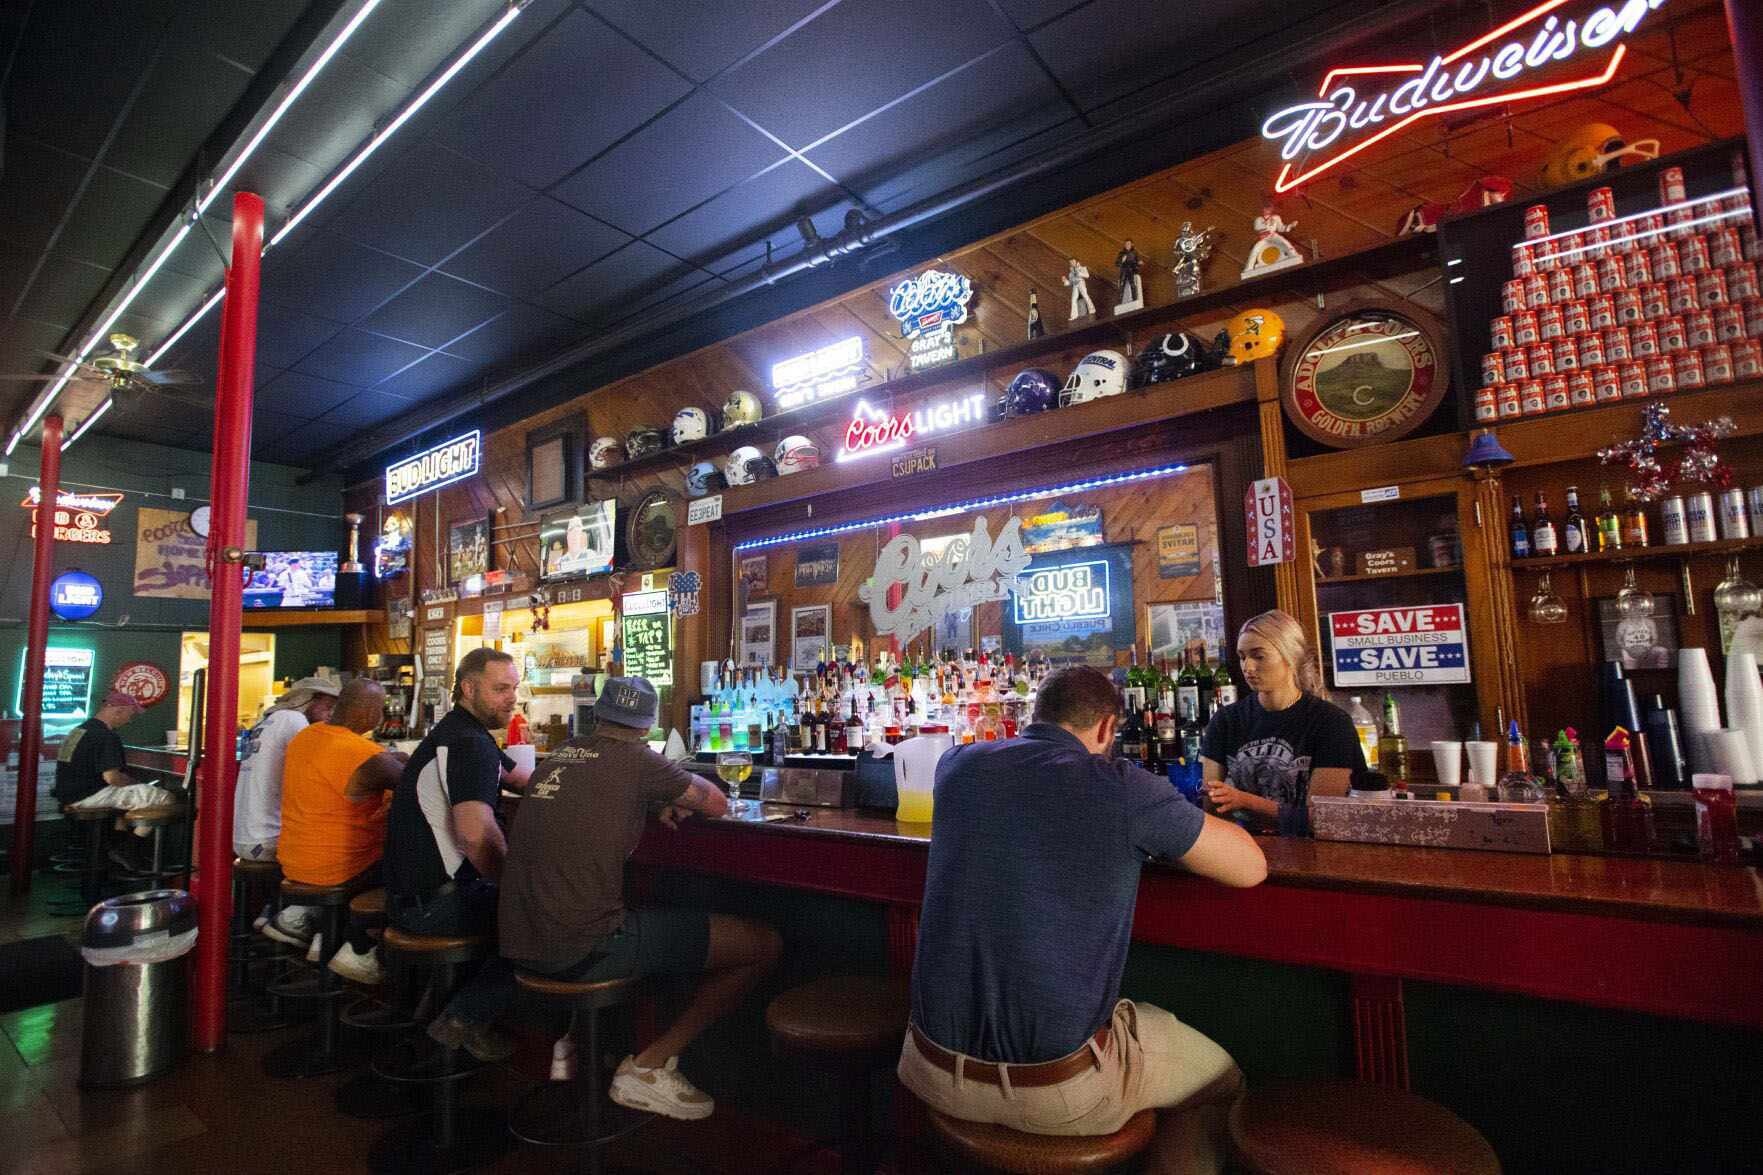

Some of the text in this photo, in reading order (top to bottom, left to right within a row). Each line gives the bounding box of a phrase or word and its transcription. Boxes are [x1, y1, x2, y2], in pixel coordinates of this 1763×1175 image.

[911, 346, 953, 368] TAVERN
[845, 394, 985, 451] Coors LIGHT
[1311, 410, 1361, 437] GOLDEN
[390, 438, 476, 498] BUD LIGHT
[892, 455, 936, 477] CSUPACK
[1365, 551, 1395, 560] Gray's
[1365, 566, 1398, 574] Tavern
[1357, 609, 1435, 634] SAVE
[1347, 633, 1448, 647] SMALL BUSINESS
[1360, 646, 1439, 670] SAVE
[1376, 671, 1424, 680] PUEBLO
